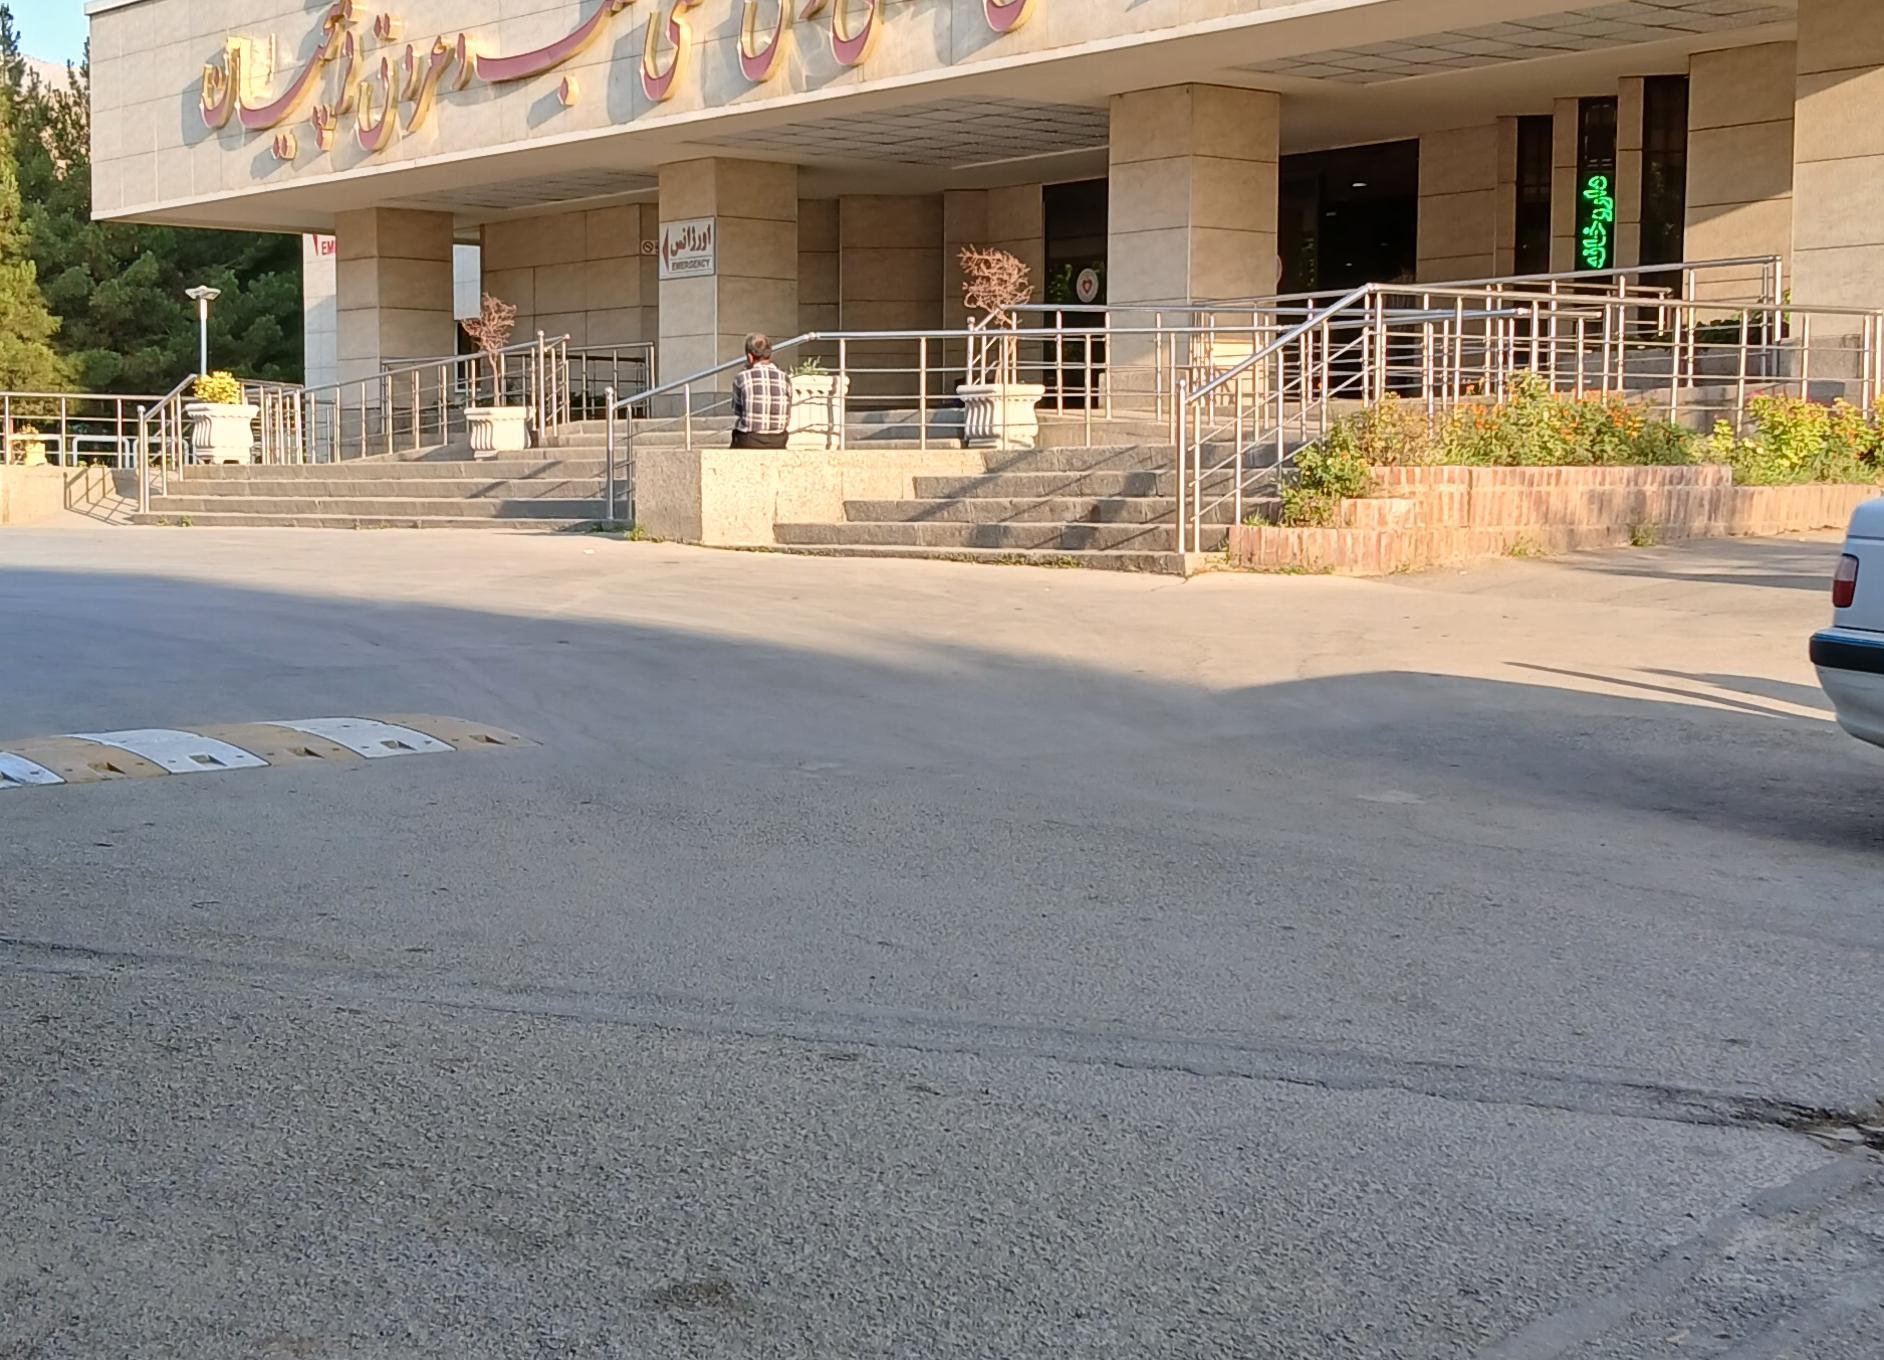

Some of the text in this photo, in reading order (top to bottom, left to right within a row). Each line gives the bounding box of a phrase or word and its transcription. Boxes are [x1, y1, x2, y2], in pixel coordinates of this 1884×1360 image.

[355, 12, 453, 151] عروق
[451, 32, 475, 92] و
[670, 223, 712, 257] اورژانس
[1582, 175, 1614, 269] داروخانه
